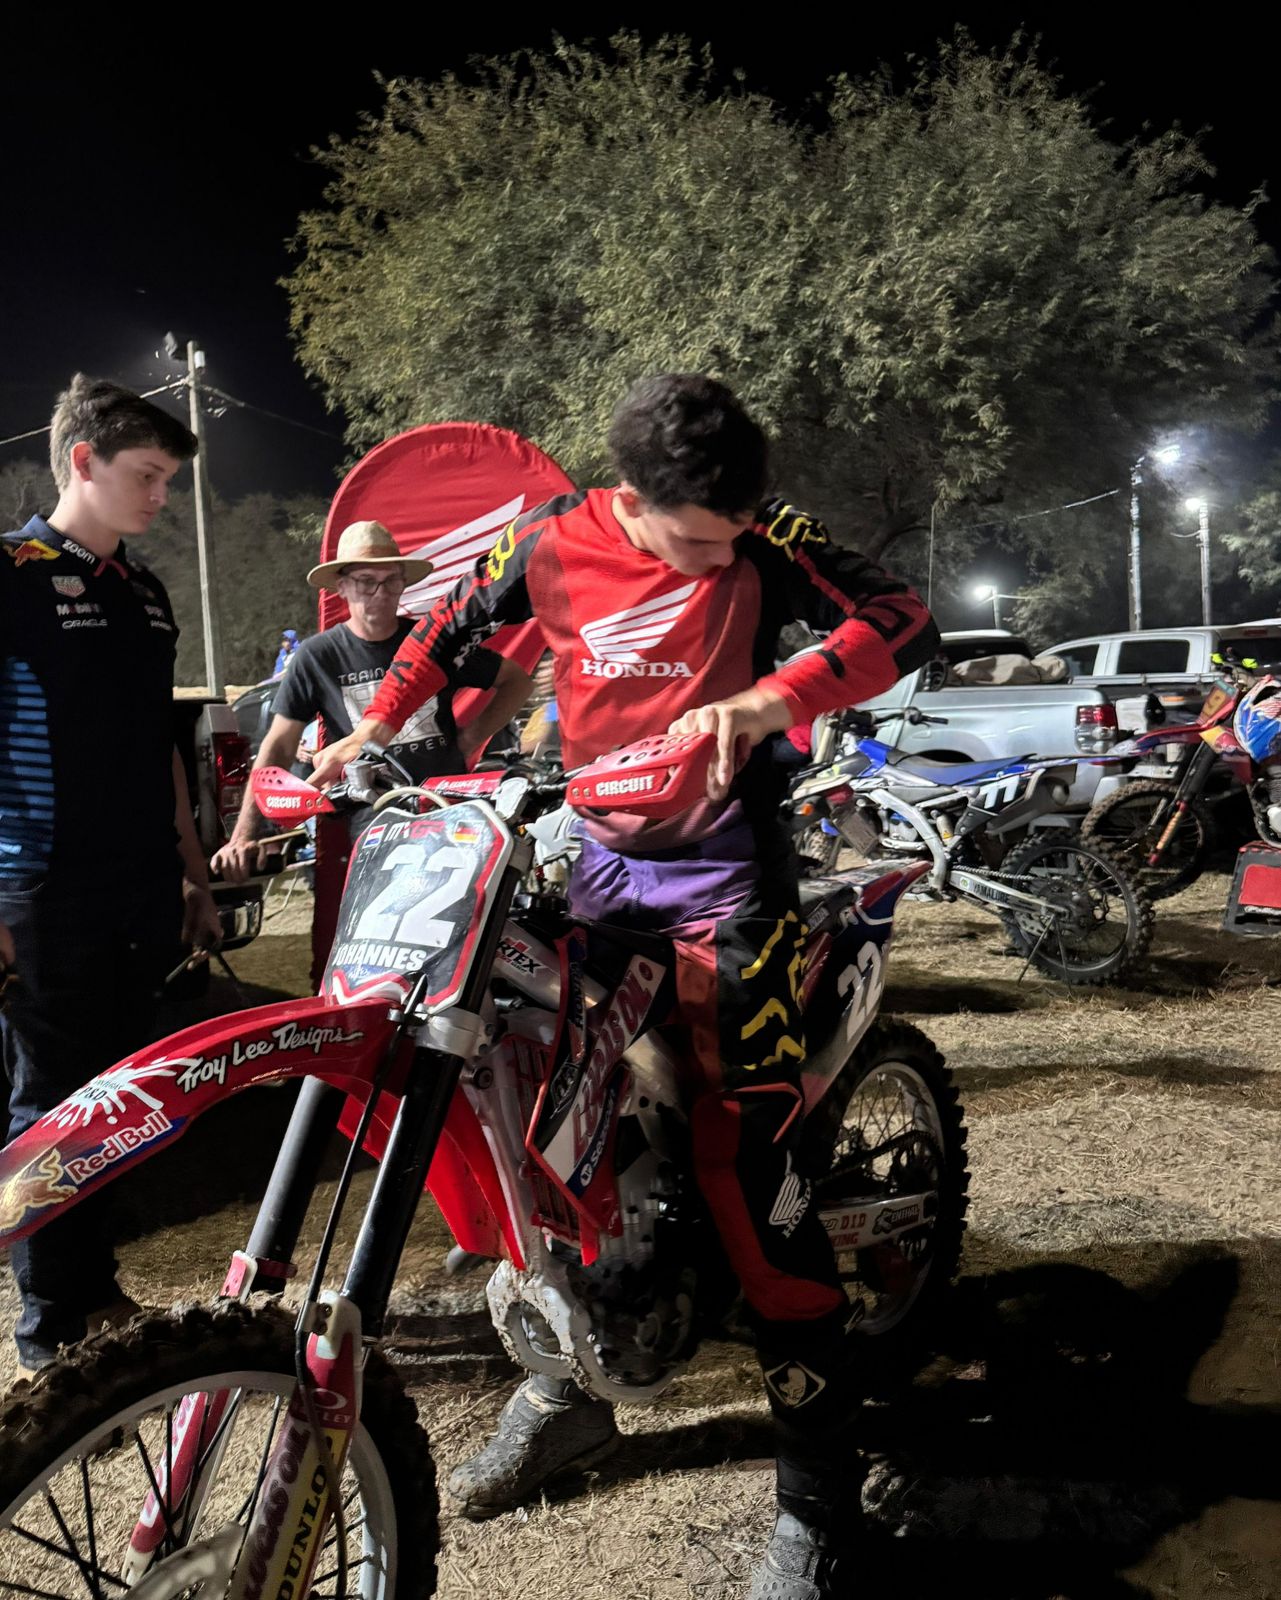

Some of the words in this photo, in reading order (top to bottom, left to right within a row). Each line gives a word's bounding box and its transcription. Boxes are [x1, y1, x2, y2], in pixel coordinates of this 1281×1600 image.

[61, 539, 96, 565] zoom
[62, 618, 108, 630] ORACLE
[581, 658, 694, 679] HONDA
[595, 774, 655, 797] CIRCUIT
[266, 796, 302, 809] CIRCUIT
[352, 844, 479, 949] 22
[331, 943, 428, 972] JOHANNES
[838, 940, 882, 1044] 22
[176, 1057, 227, 1094] Troy
[232, 1039, 276, 1067] Lee
[272, 1022, 364, 1055] Designs
[66, 1135, 123, 1184] Red
[113, 1110, 173, 1154] Bull
